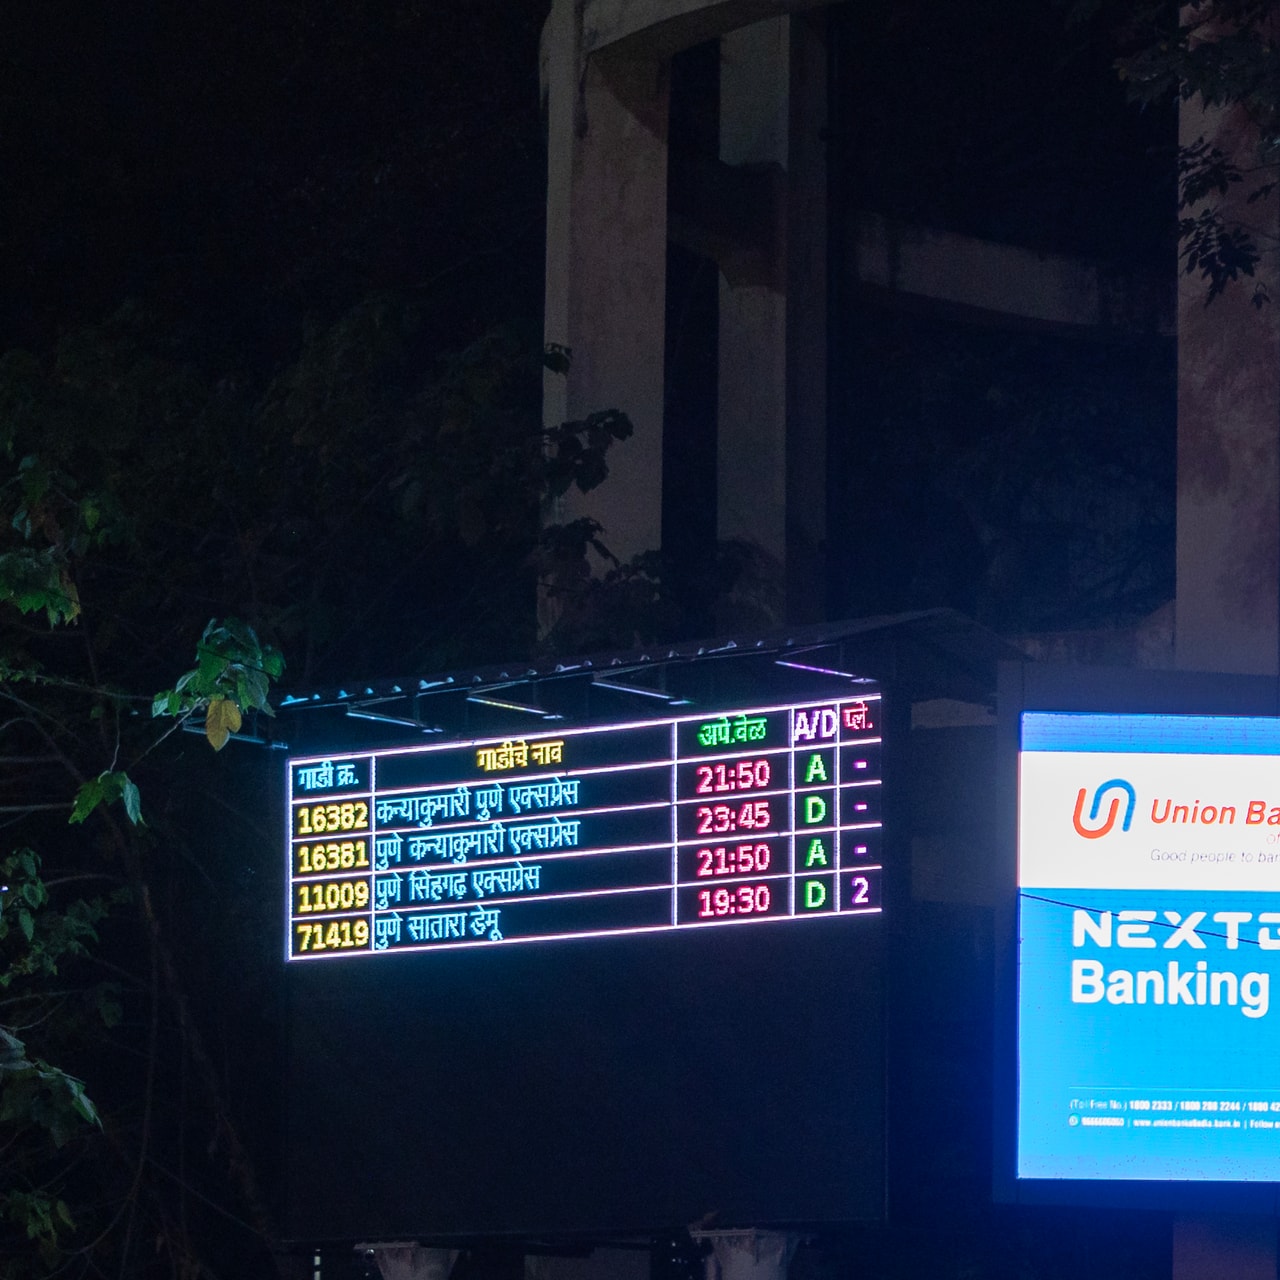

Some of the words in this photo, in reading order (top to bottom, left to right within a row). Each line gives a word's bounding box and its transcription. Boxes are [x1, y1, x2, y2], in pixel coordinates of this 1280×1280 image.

[298, 761, 334, 790] गाडी
[477, 740, 529, 772] गाडीचे
[531, 740, 564, 765] नाव
[793, 709, 838, 741] A/D
[297, 801, 369, 835] 16382
[376, 786, 472, 828] कन्याकुमारी
[475, 782, 505, 821] पुणे
[508, 776, 581, 814] एक्सप्रेस
[697, 760, 770, 794] 21:50
[805, 753, 827, 783] A
[1150, 799, 1236, 825] Union
[297, 840, 370, 873] 16381
[375, 832, 404, 871] पुणे
[408, 821, 506, 865] कन्याकुमारी
[508, 816, 581, 854] एक्सप्रेस
[697, 801, 770, 834] 23:45
[805, 795, 826, 824] D
[1150, 848, 1187, 862] Good
[1191, 850, 1236, 865] people
[1240, 851, 1254, 863] to
[1266, 832, 1280, 845] of
[297, 880, 370, 913] 11009
[375, 872, 404, 910] पुणे
[472, 860, 542, 898] एक्सप्रेस
[697, 843, 770, 876] 21:50
[805, 838, 827, 867] A
[296, 919, 370, 952] 71419
[375, 911, 404, 950] पुणे
[408, 912, 468, 941] सातारा
[470, 904, 504, 941] डेमू
[698, 885, 770, 917] 19:30
[805, 880, 826, 908] D
[851, 875, 869, 904] 2
[1071, 959, 1270, 1019] Banking
